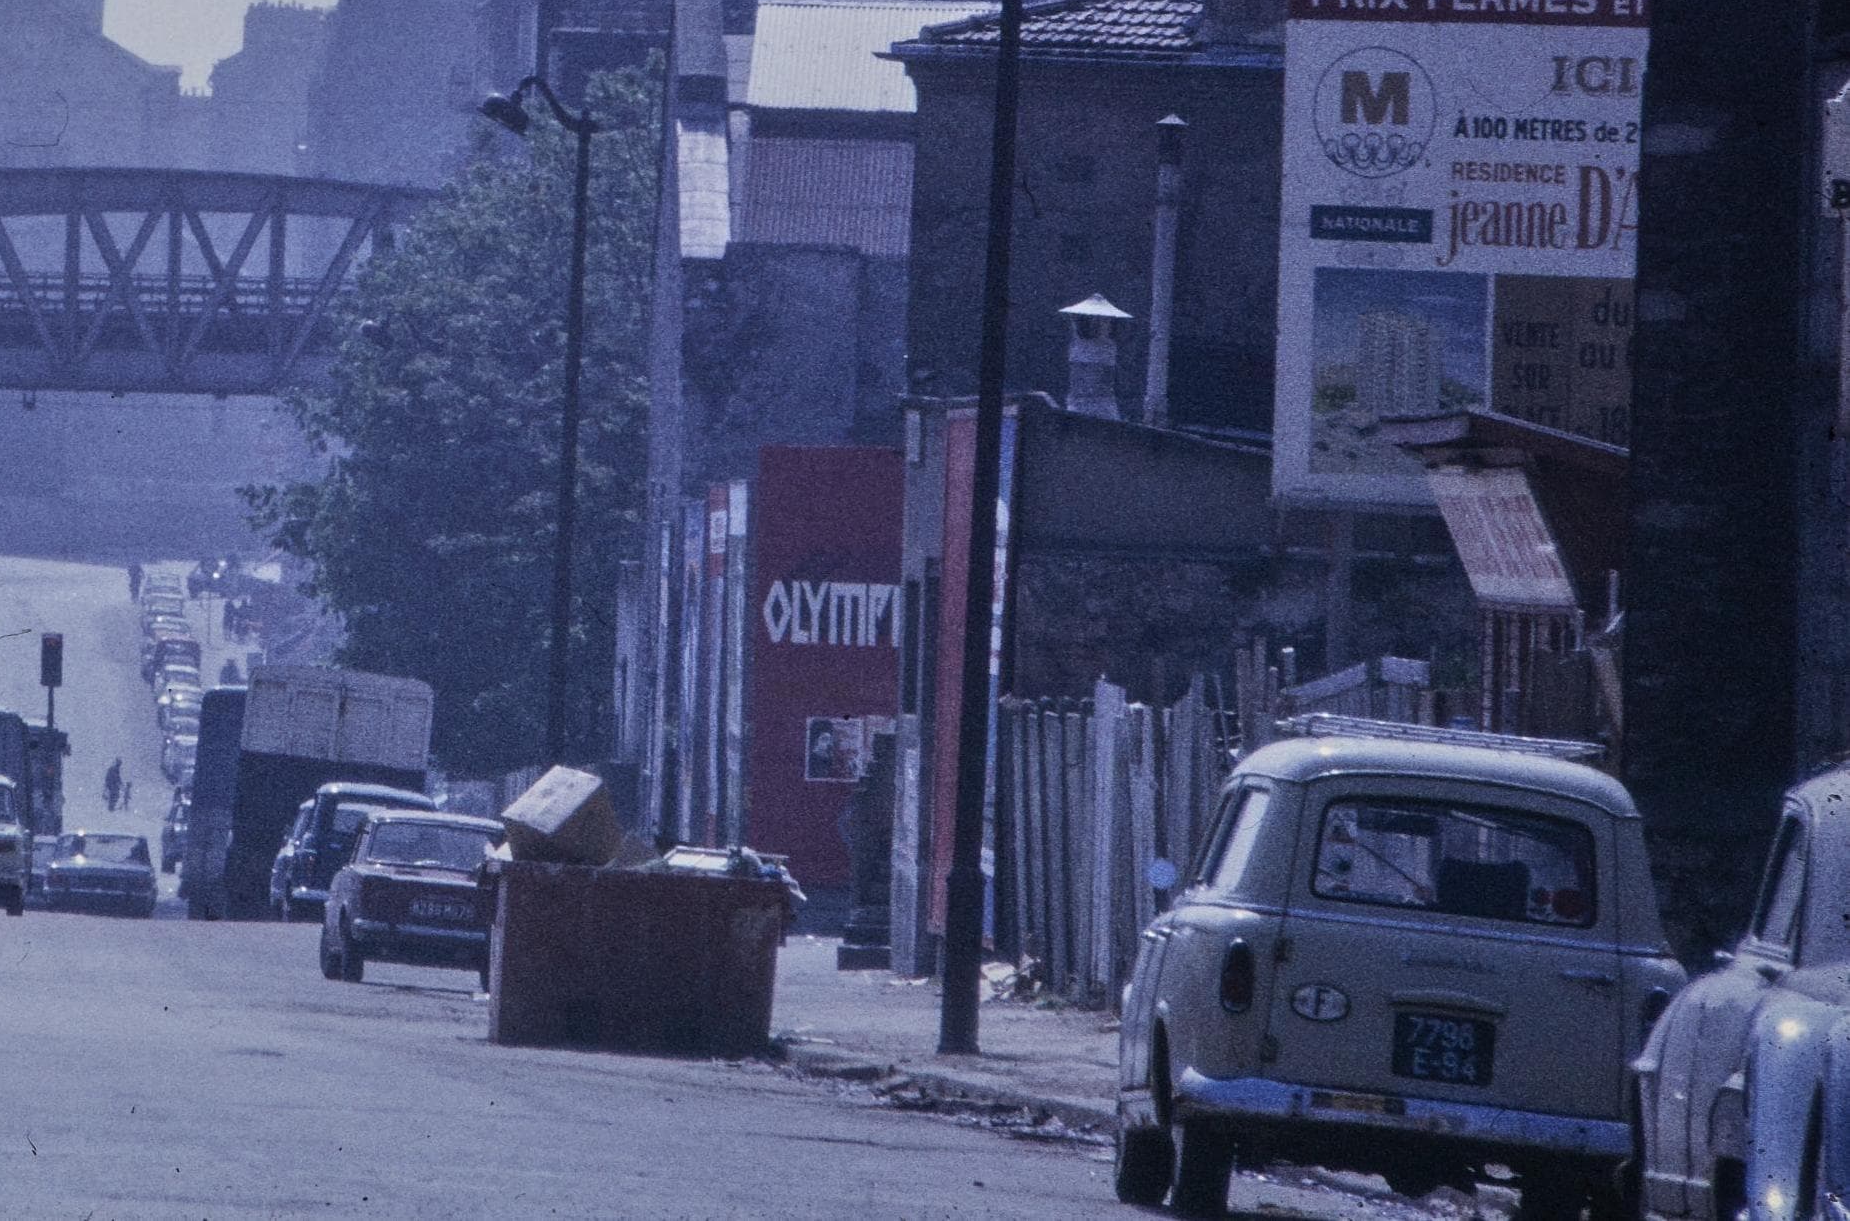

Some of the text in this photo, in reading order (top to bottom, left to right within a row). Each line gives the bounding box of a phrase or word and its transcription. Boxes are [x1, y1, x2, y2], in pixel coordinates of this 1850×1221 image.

[1550, 56, 1639, 94] ICI
[1340, 69, 1410, 125] M
[1593, 120, 1620, 143] de
[1320, 215, 1420, 234] NATIONALE
[1436, 190, 1566, 267] jeanne
[761, 579, 902, 648] OLYMPI
[1313, 986, 1331, 1018] F
